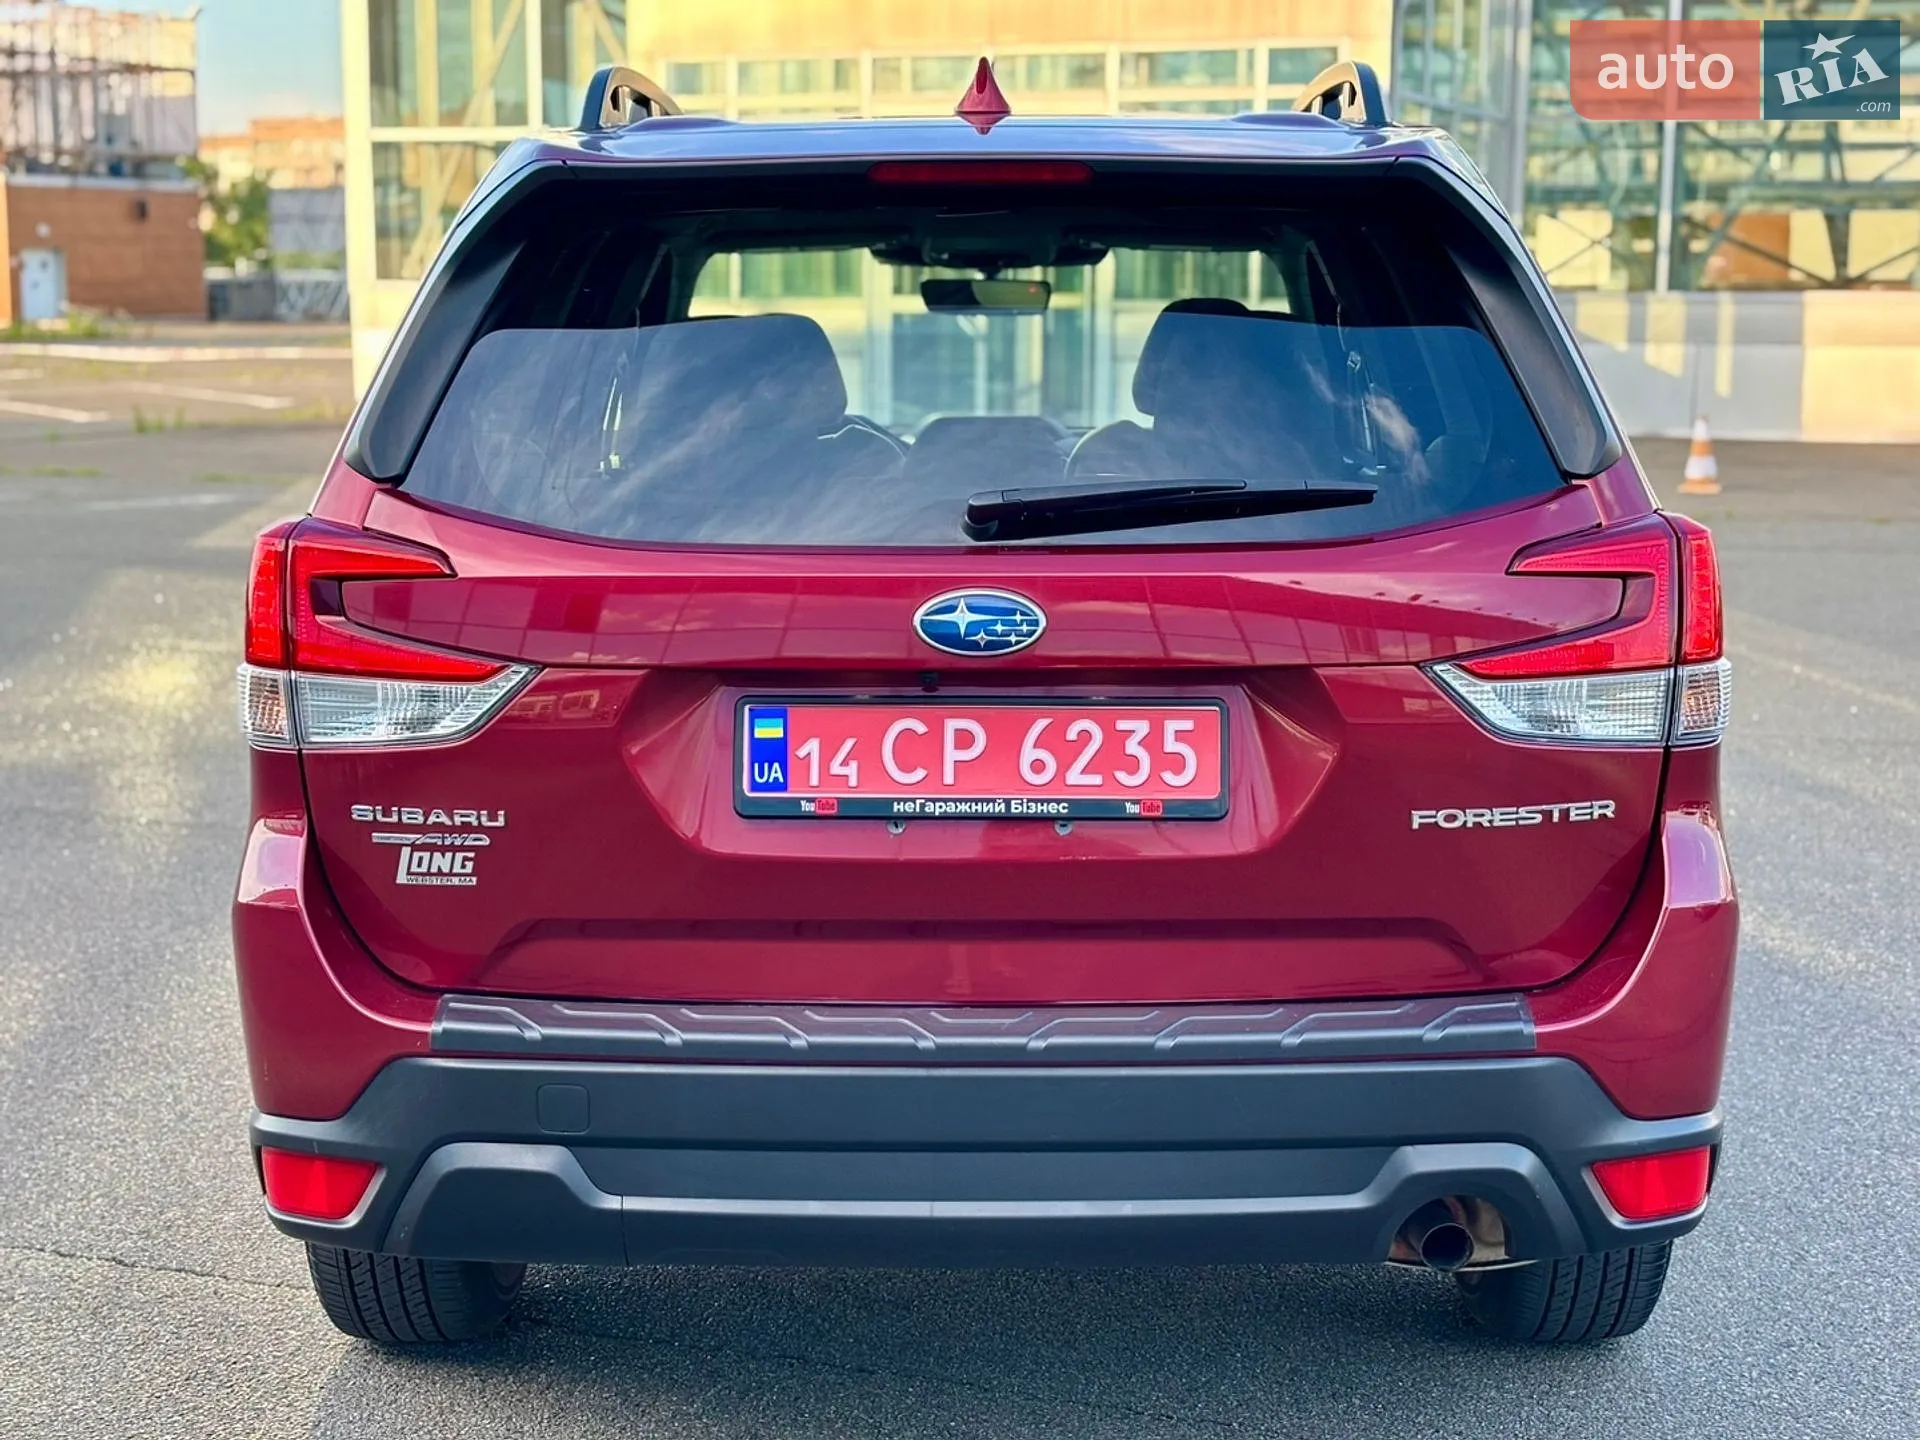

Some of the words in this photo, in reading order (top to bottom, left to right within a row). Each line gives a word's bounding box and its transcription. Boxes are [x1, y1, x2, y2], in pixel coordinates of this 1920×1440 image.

[794, 736, 859, 787] 14
[881, 717, 987, 786] CP
[1018, 717, 1198, 787] 6235
[753, 762, 784, 783] UA
[351, 804, 506, 828] SUBARU
[893, 799, 1006, 816] неГаражний
[1010, 799, 1069, 814] Бізнес
[1411, 799, 1617, 830] FORESTER
[415, 832, 491, 847] AWD
[396, 846, 476, 885] LONG
[458, 877, 475, 885] MA
